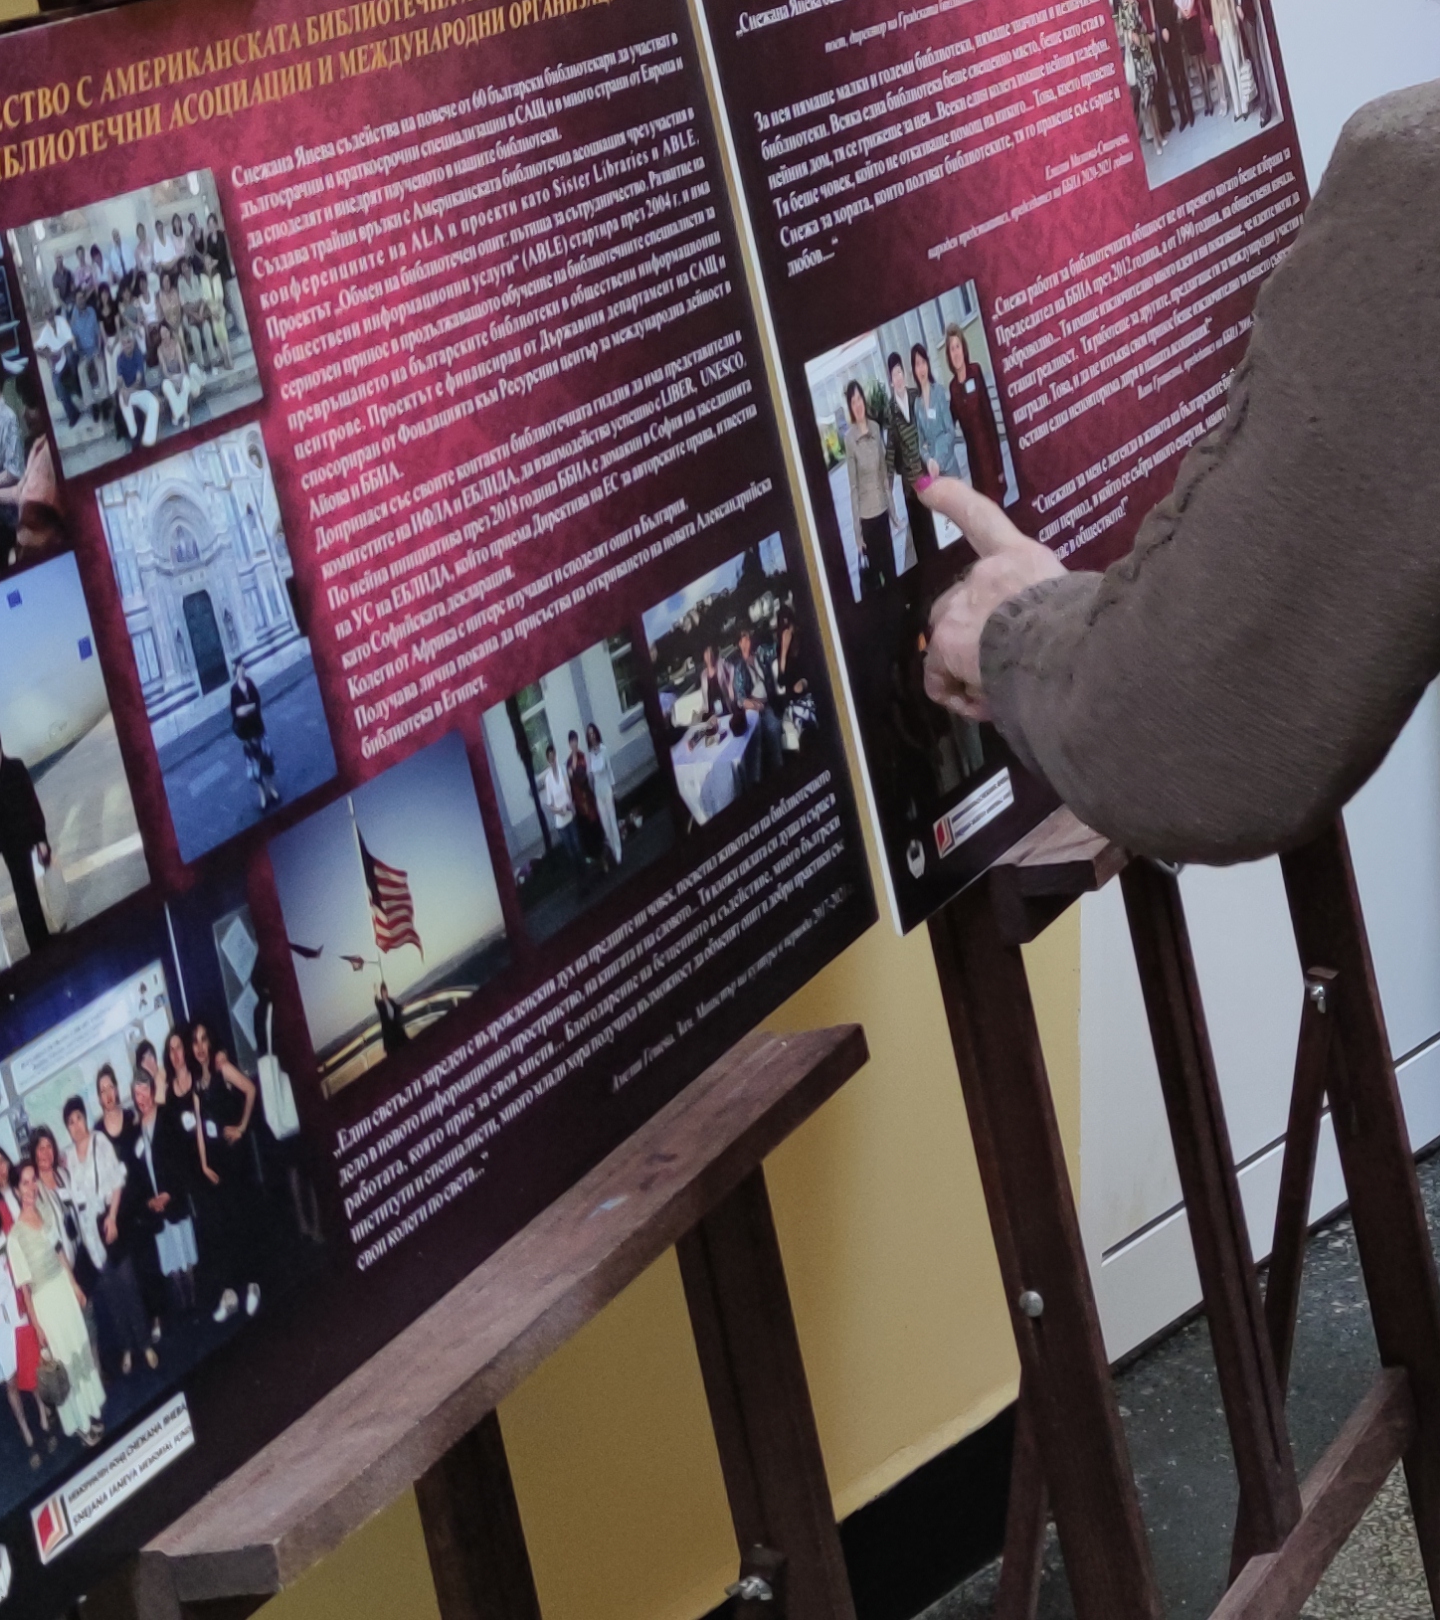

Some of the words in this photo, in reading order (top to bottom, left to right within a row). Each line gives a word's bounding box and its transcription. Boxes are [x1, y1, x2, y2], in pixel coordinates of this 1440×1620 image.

[74, 75, 93, 110] С
[97, 20, 301, 104] АМЕРИКАНСКАТА
[168, 61, 313, 131] АСОЦИАЦИИ
[317, 55, 334, 87] И
[338, 6, 506, 81] МЕЖДУНАРОДНИ
[259, 249, 384, 307] конференциите
[409, 222, 443, 250] ALA
[460, 200, 517, 232] проекти
[520, 188, 550, 209] като
[552, 173, 590, 197] Sister
[592, 151, 649, 182] Libraries
[321, 531, 395, 579] комитетите
[410, 497, 452, 533] ИФЛА
